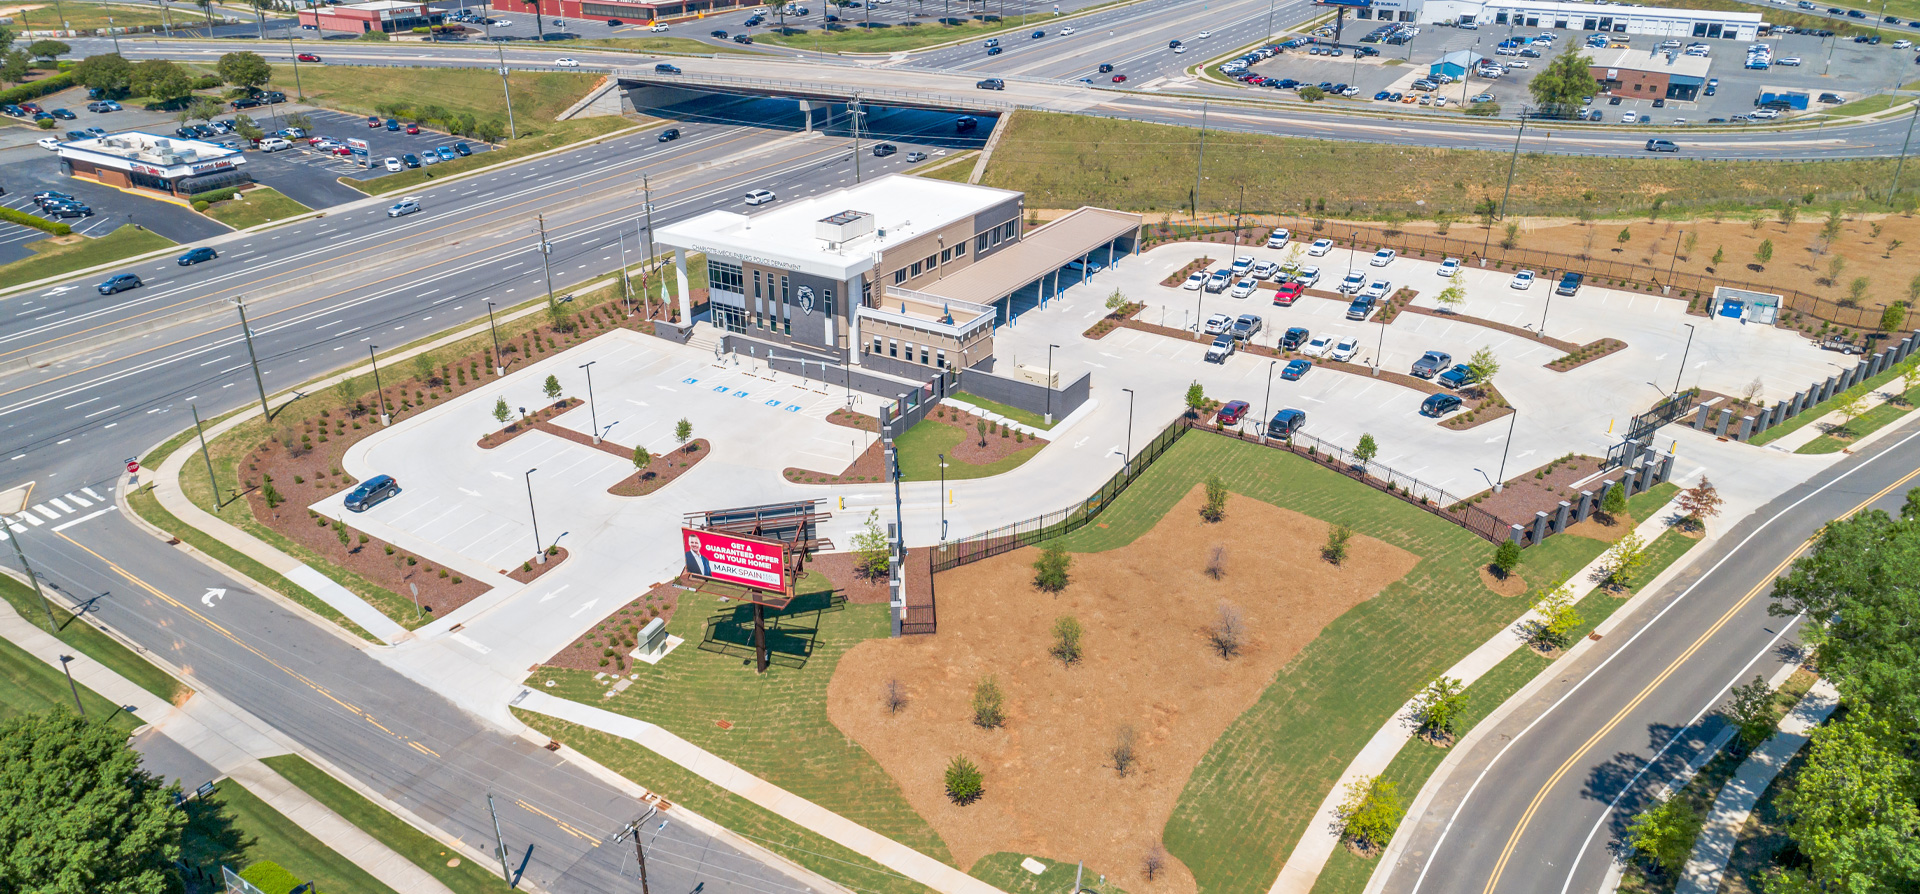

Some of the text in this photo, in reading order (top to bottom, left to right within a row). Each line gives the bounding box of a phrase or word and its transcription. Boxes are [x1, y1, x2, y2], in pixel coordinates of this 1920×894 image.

[692, 244, 800, 270] CHARLOTTE-MECKLENBURG POLICE DEPARTMENT
[706, 545, 779, 564] GUARANTEED OFFER
[726, 555, 746, 564] YOUR
[748, 559, 771, 569] HOME!
[714, 564, 763, 579] MARK SPAIN
